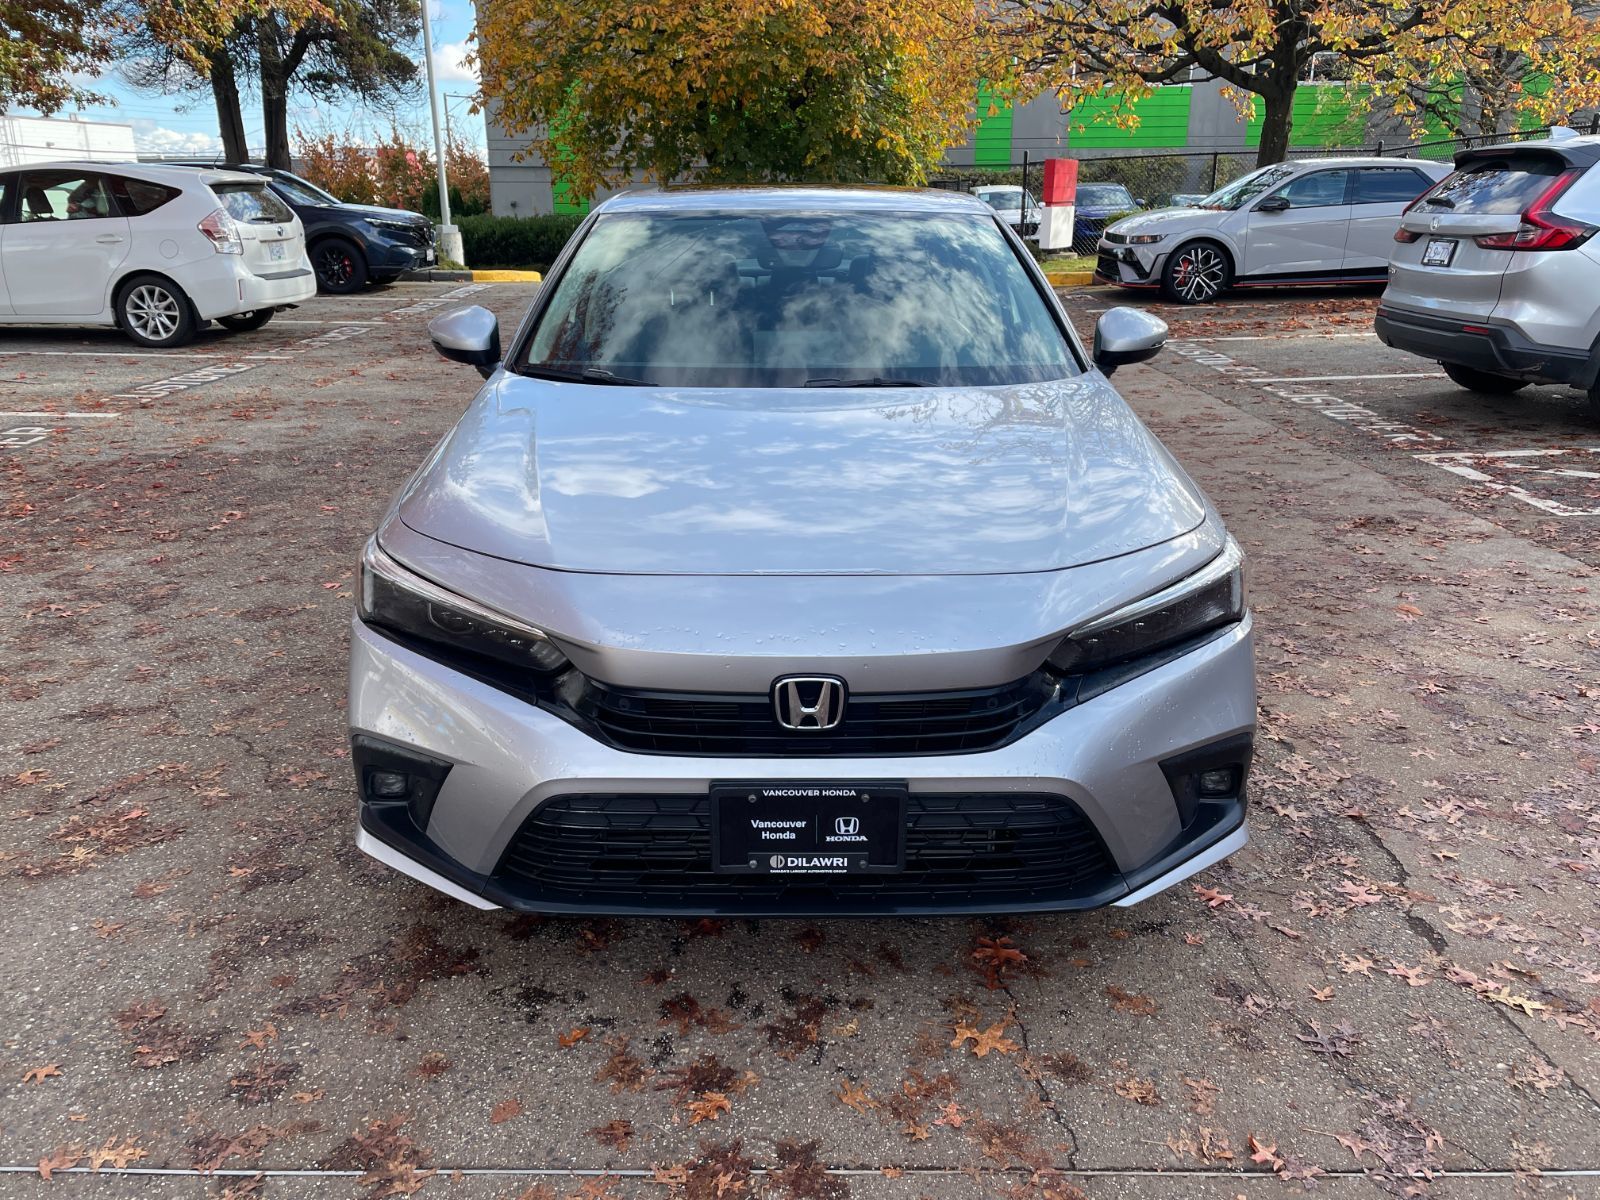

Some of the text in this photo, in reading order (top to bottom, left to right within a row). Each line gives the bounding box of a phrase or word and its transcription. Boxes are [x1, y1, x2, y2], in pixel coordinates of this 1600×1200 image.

[751, 820, 807, 828] Vancouver
[761, 831, 796, 840] Honda
[787, 857, 848, 867] DILAWRI
